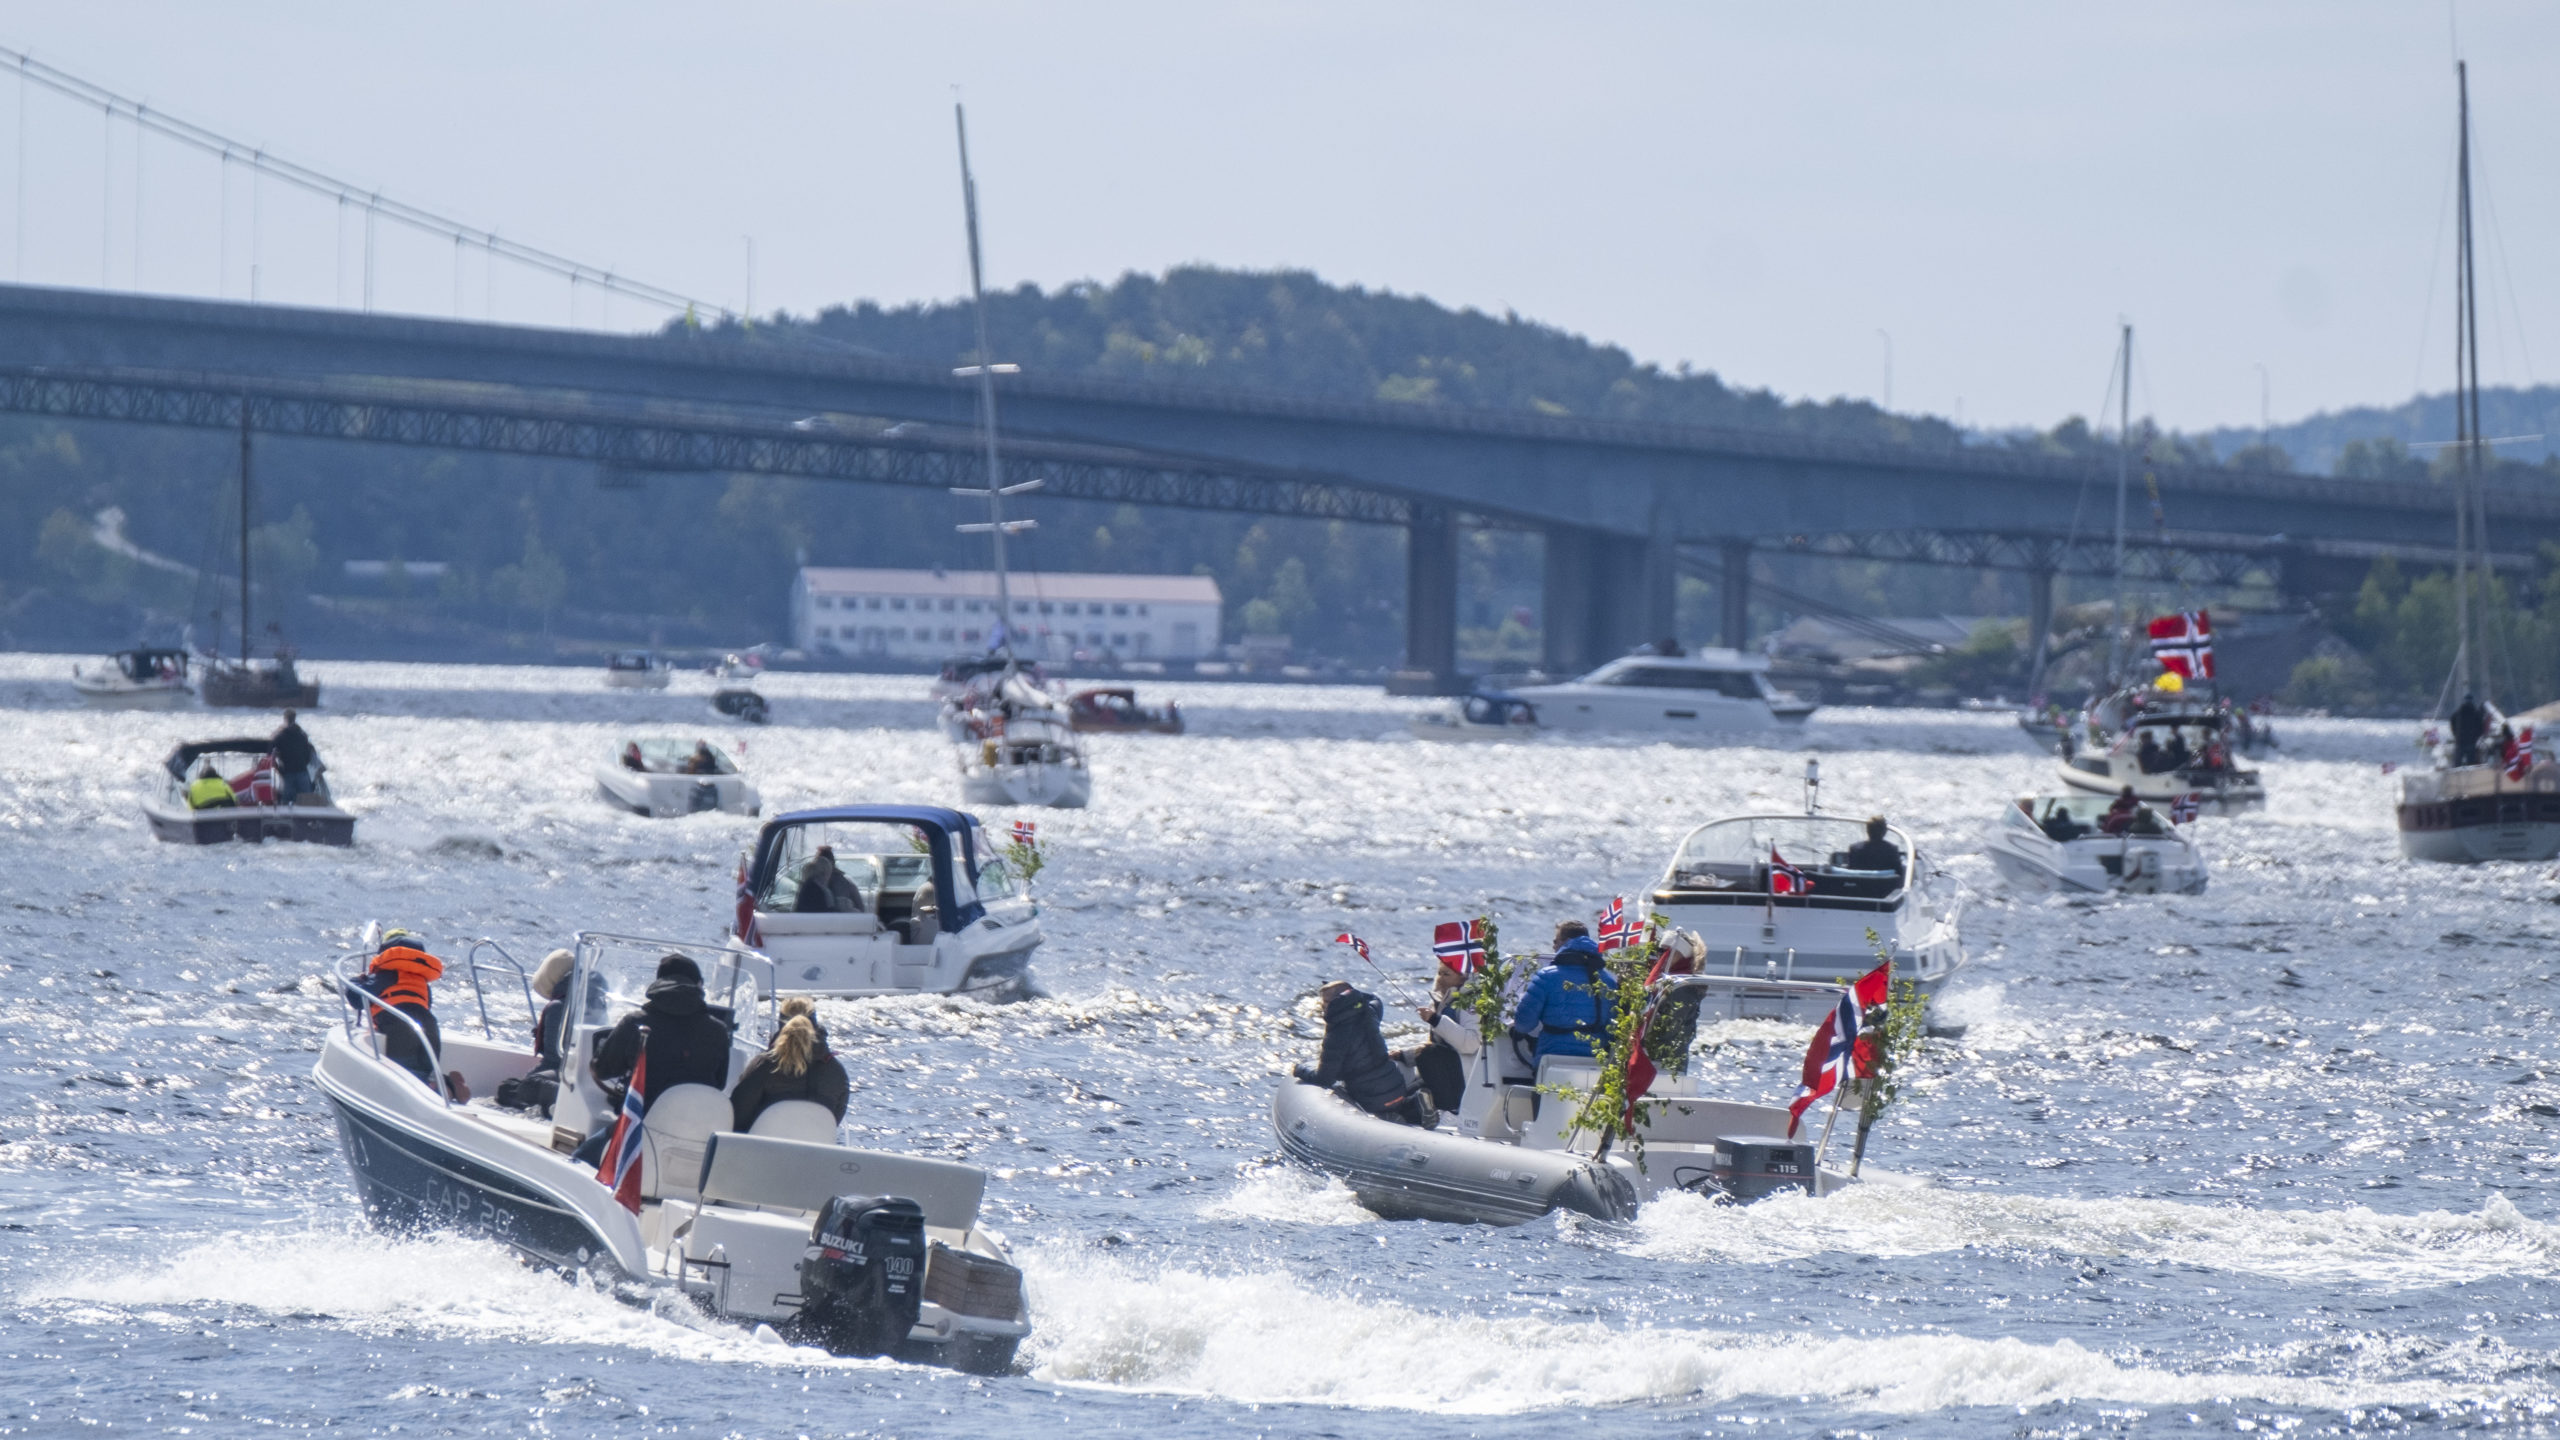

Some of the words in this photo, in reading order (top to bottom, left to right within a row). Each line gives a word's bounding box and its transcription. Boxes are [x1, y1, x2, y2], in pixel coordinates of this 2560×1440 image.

[1779, 1164, 1799, 1174] 115
[426, 1179, 471, 1215] CAP
[820, 1232, 864, 1254] SUZUKI
[884, 1256, 914, 1275] 140
